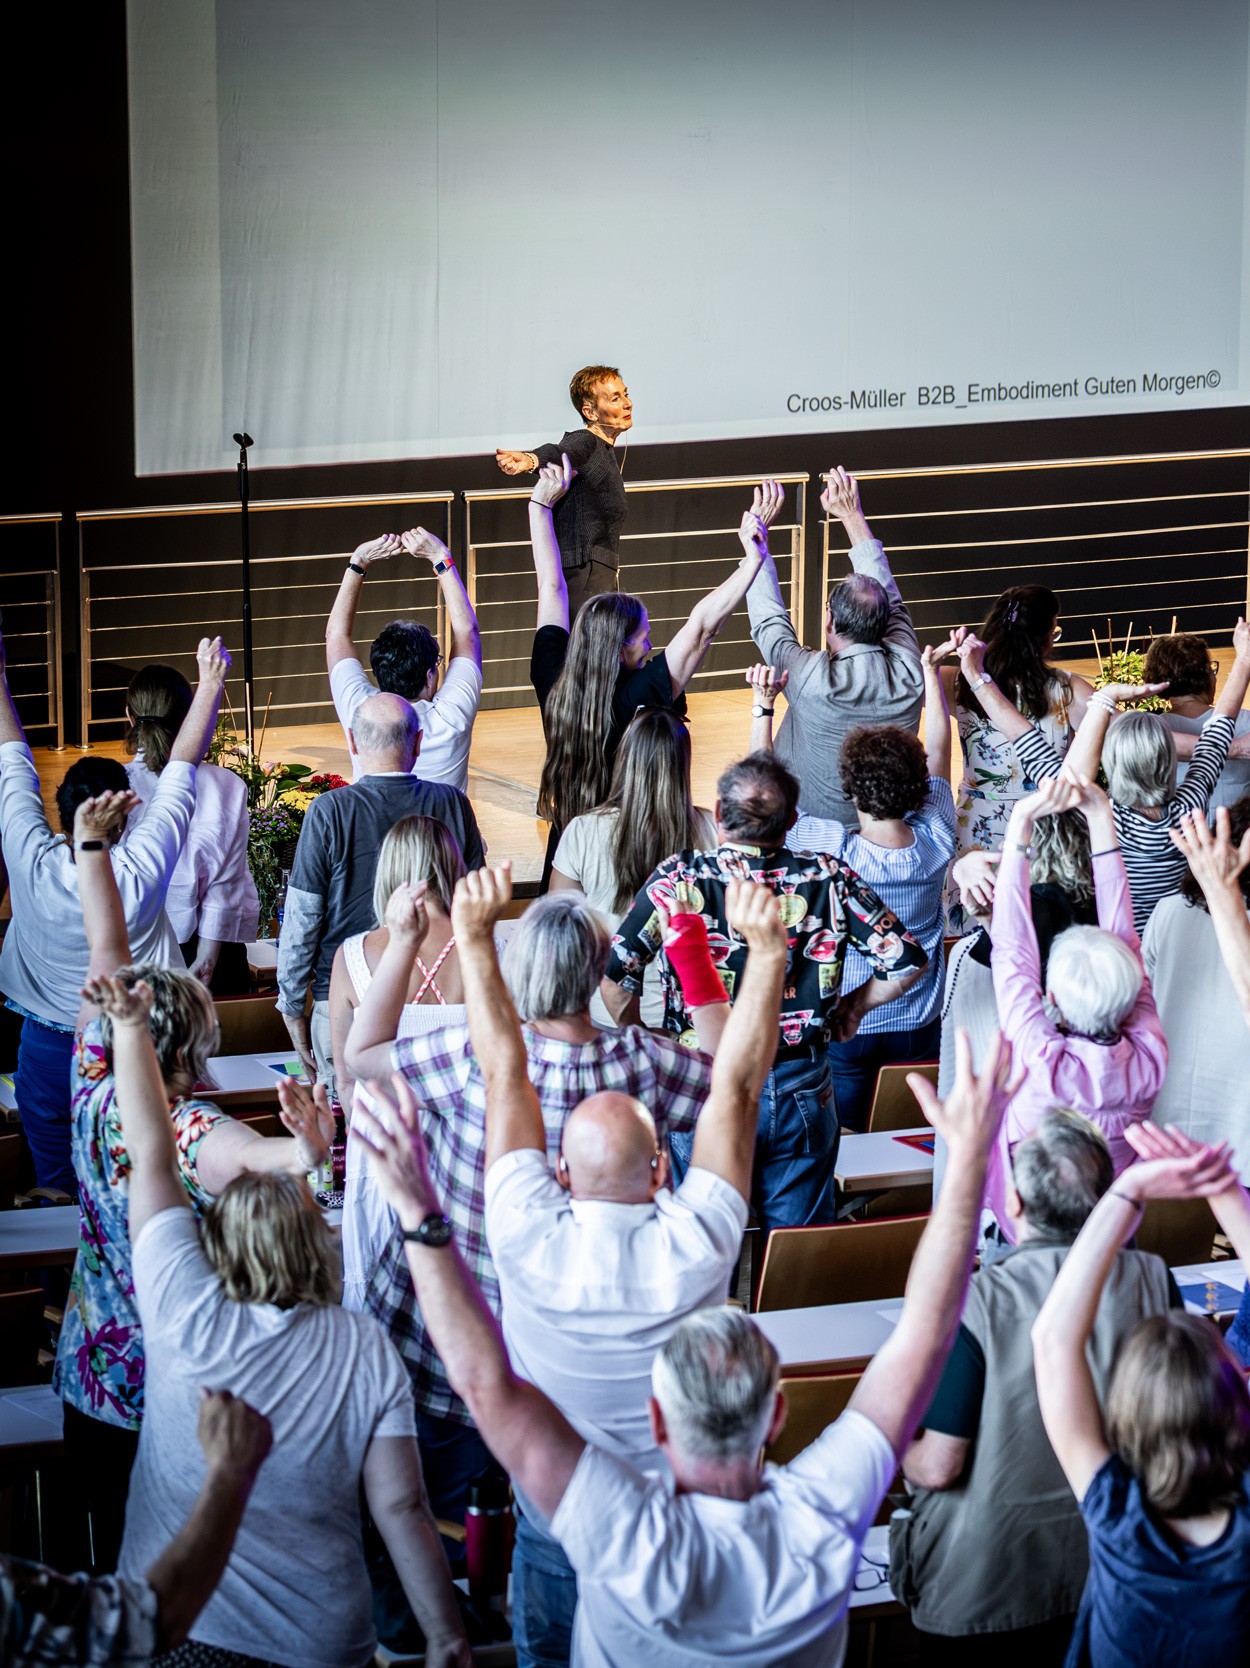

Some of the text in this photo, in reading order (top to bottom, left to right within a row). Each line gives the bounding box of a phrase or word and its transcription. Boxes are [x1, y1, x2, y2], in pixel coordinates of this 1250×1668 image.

[786, 388, 907, 414] Croos-Müller
[917, 377, 1079, 409] B2B_Embodiment
[1084, 376, 1137, 396] Guten
